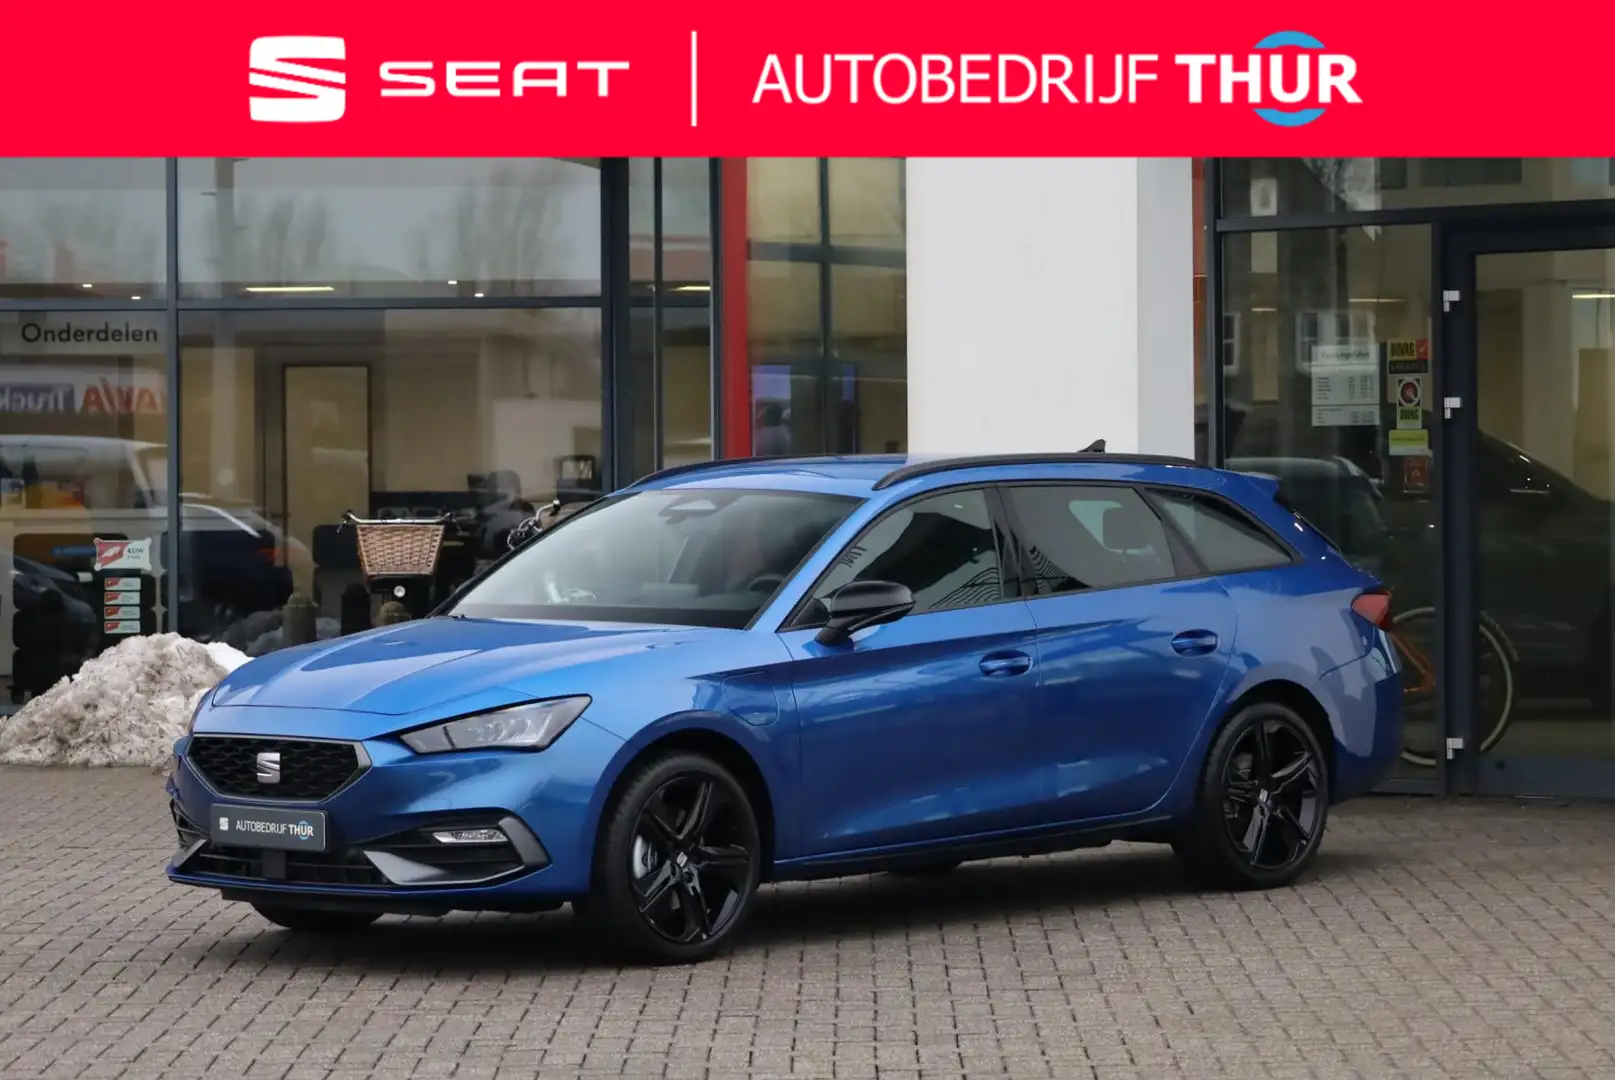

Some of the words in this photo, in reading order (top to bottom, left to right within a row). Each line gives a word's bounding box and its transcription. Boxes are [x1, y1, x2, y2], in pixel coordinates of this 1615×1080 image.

[21, 321, 158, 343] Onderdelen
[235, 819, 288, 834] AUTOBEDRIJF
[288, 823, 315, 838] THUR
